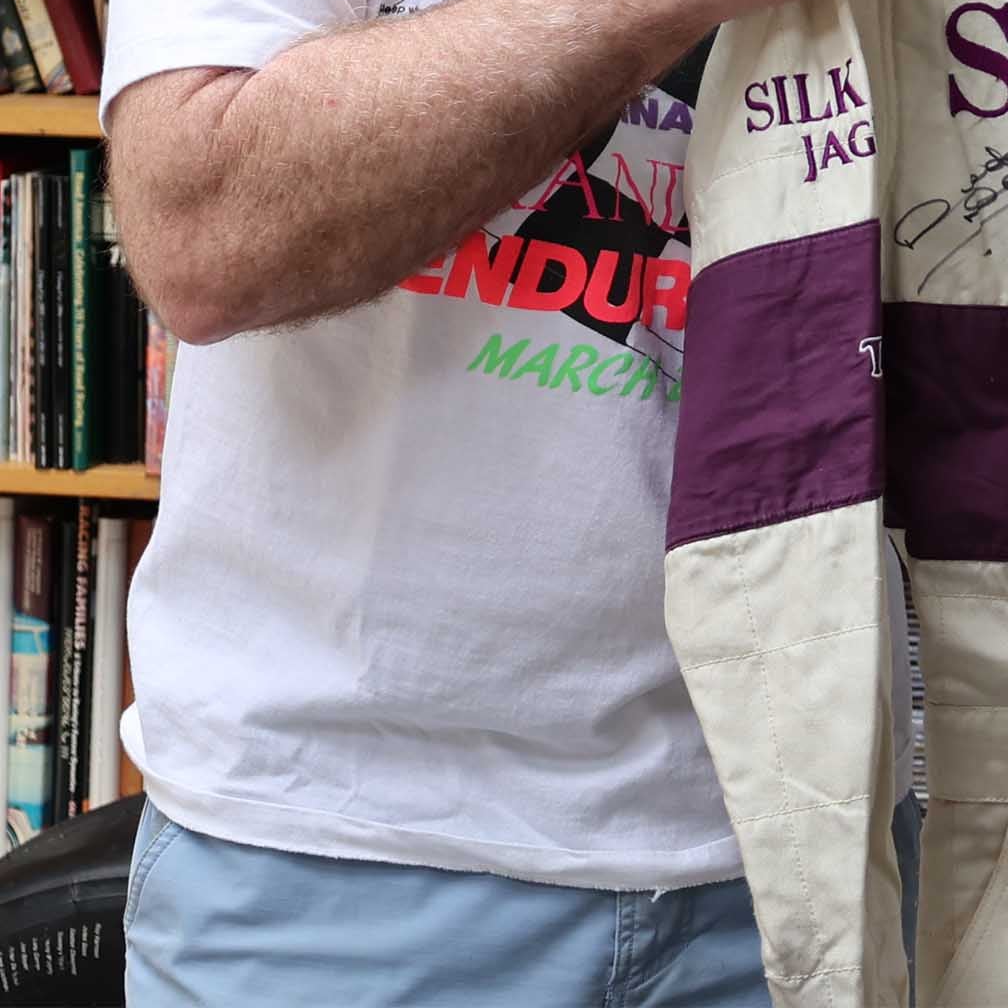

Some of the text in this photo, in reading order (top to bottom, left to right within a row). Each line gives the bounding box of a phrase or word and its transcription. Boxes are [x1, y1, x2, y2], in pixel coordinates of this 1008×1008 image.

[744, 58, 867, 134] SILK
[801, 120, 877, 183] JAG
[466, 334, 661, 401] MARCH
